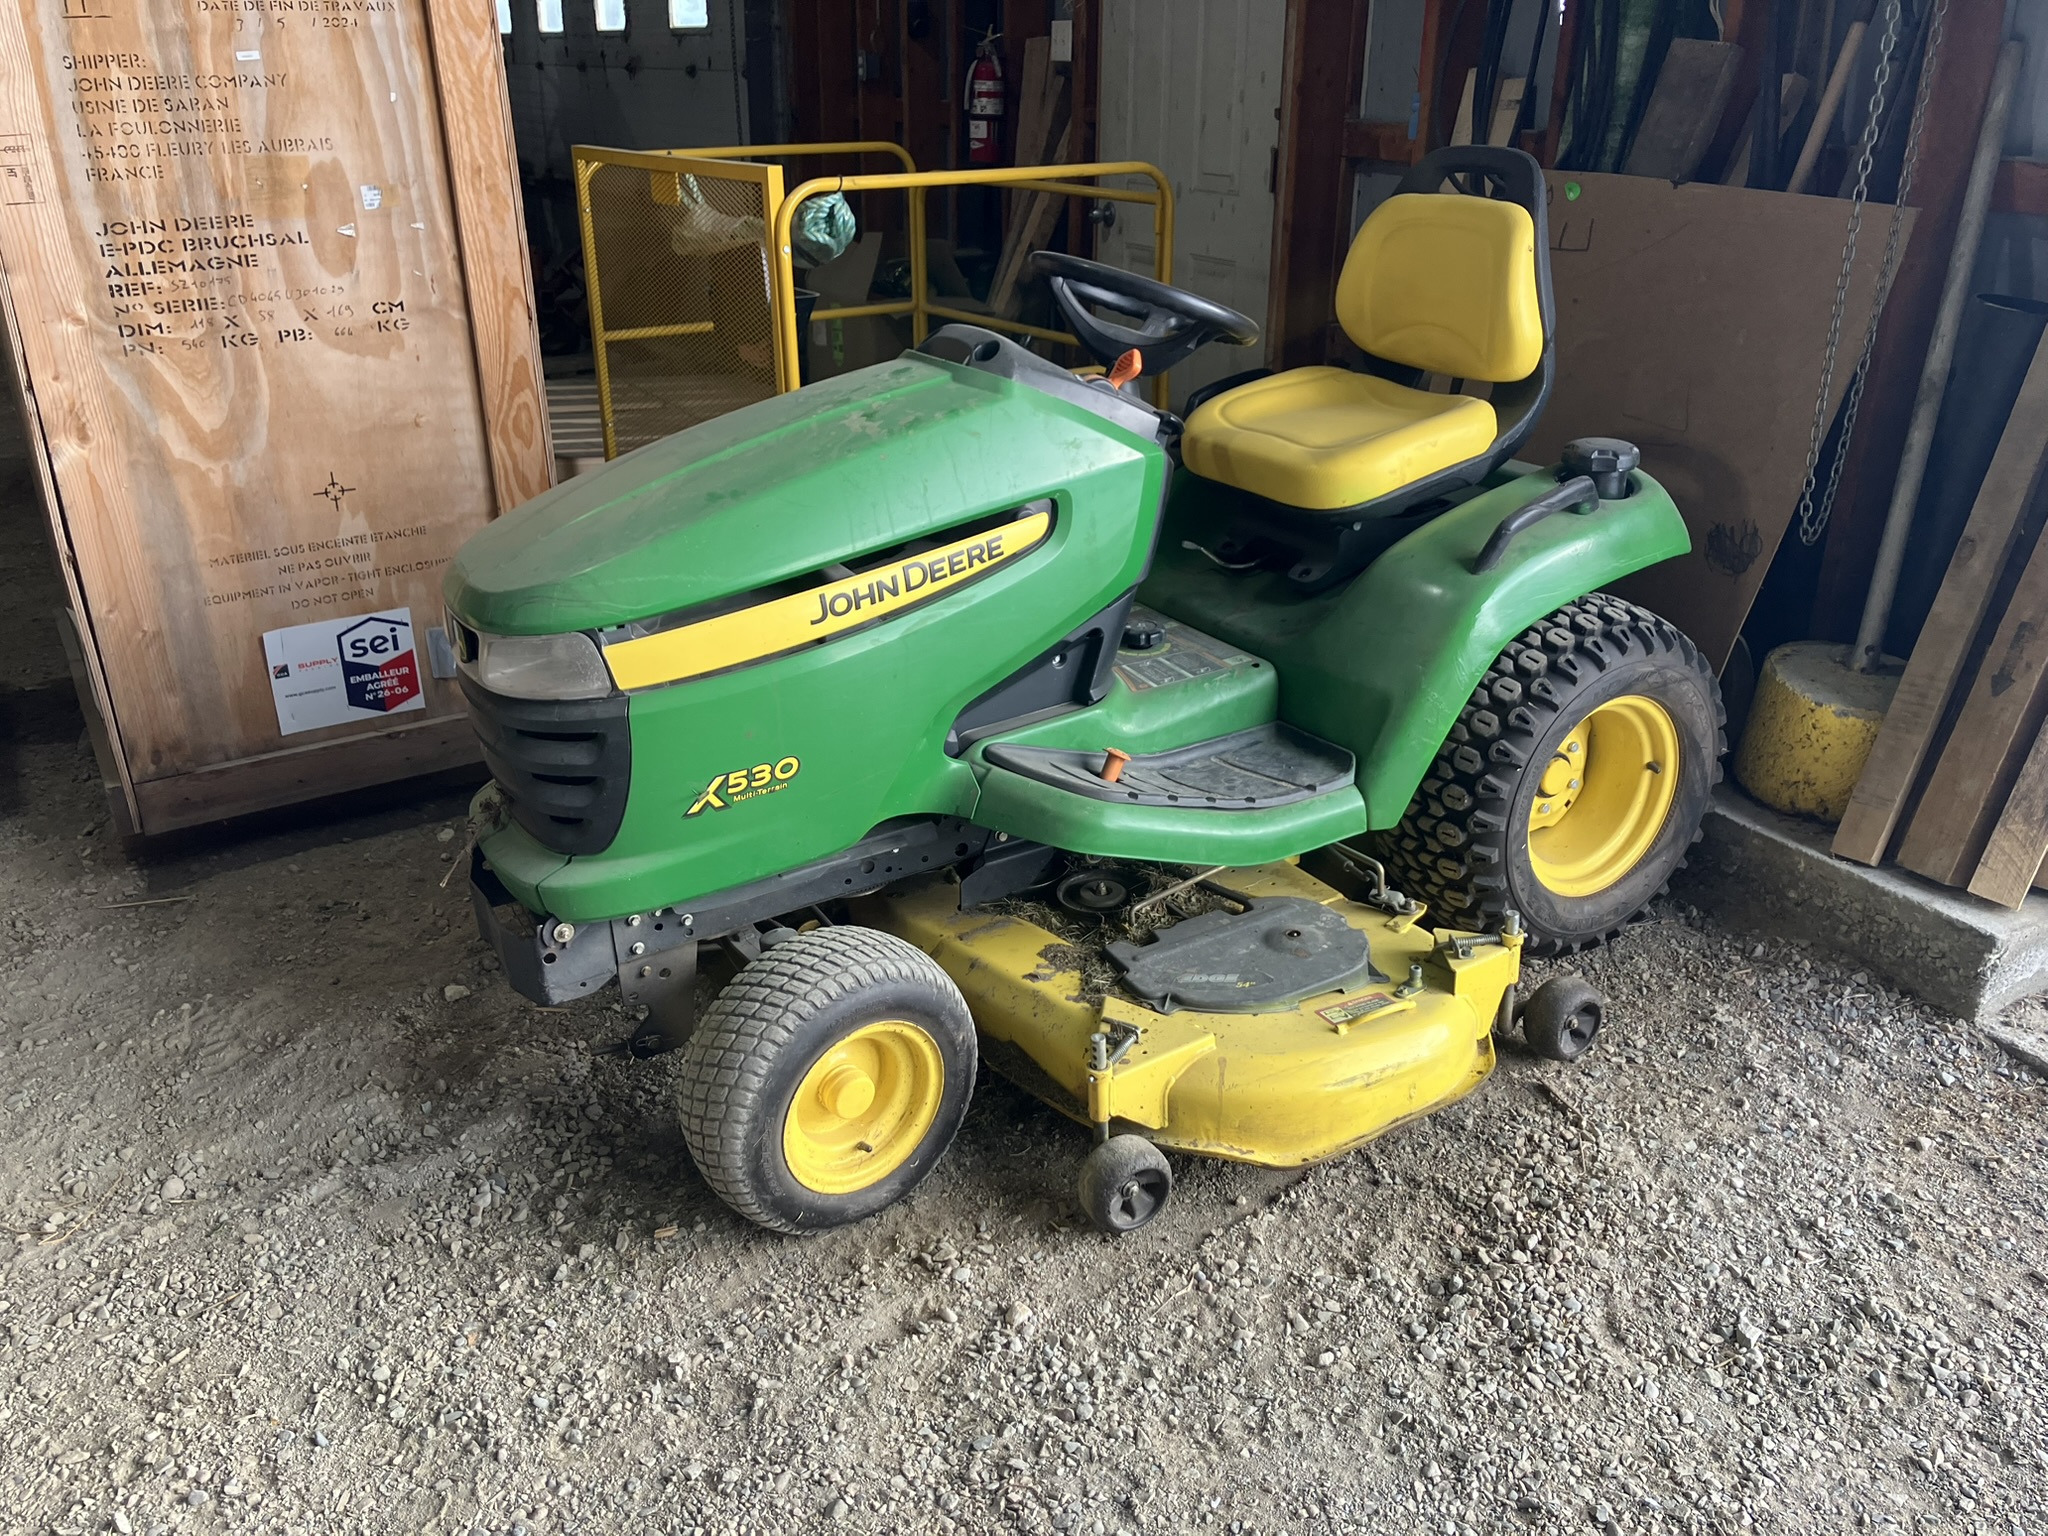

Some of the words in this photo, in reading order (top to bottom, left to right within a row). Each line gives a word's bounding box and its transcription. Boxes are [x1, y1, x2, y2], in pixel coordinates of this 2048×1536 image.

[197, 0, 239, 11] DATE
[243, 0, 265, 11] DE
[269, 0, 294, 11] FIN
[299, 0, 319, 11] DE
[324, 0, 396, 12] TRAVAUX
[276, 17, 286, 30] 5
[322, 16, 358, 28] 2024
[62, 54, 147, 70] SHIPPER:
[68, 77, 122, 92] JOHN
[127, 75, 190, 91] DEERE
[195, 72, 287, 89] COMPANY
[72, 98, 127, 115] USINE
[132, 98, 159, 113] DE
[164, 97, 229, 113] SARAN
[76, 123, 103, 138] LA
[107, 118, 241, 137] FOULONNERIE
[82, 143, 141, 160] 45400
[146, 140, 213, 157] FLEURY
[221, 139, 252, 155] LES
[258, 136, 334, 154] AUBRAIS
[85, 164, 164, 182] FRANCE
[95, 218, 168, 237] JOHN
[174, 213, 254, 232] DEERE
[99, 239, 174, 258] E-PDC
[182, 231, 309, 252] BRUCHSAL
[105, 253, 259, 279] ALLEMAGNE
[108, 281, 163, 298] REF:
[153, 297, 226, 315] SERIE:
[118, 321, 172, 339] DIM:
[223, 314, 240, 329] X
[303, 307, 319, 322] X
[372, 300, 405, 314] CM
[122, 341, 164, 358] PN:
[221, 332, 259, 349] KG
[278, 327, 313, 343] PB:
[377, 317, 410, 333] KG
[208, 549, 271, 569] MATERIEL
[273, 544, 305, 558] SOUS
[308, 534, 368, 552] ENCEINTE
[370, 525, 427, 543] ETANCHE
[278, 563, 295, 576] NE
[298, 560, 322, 573] PAS
[324, 551, 371, 568] OUVRIR
[203, 585, 275, 607] EQUIPMENT
[278, 582, 292, 595] IN
[295, 575, 339, 591] VAPOR
[347, 568, 382, 583] TIGHT
[384, 556, 452, 577] ENCLOSU
[810, 573, 900, 626] JOHN
[902, 534, 1005, 593] DEERE
[291, 597, 310, 610] DO
[313, 592, 338, 607] NOT
[340, 587, 375, 602] OPEN
[350, 626, 400, 658] sei
[297, 656, 339, 670] SUPPLY
[349, 666, 410, 684] EMBALLEUR
[366, 676, 400, 692] AGRÉÉ
[682, 755, 801, 819] X530
[733, 782, 788, 803] Multi-Terrain
